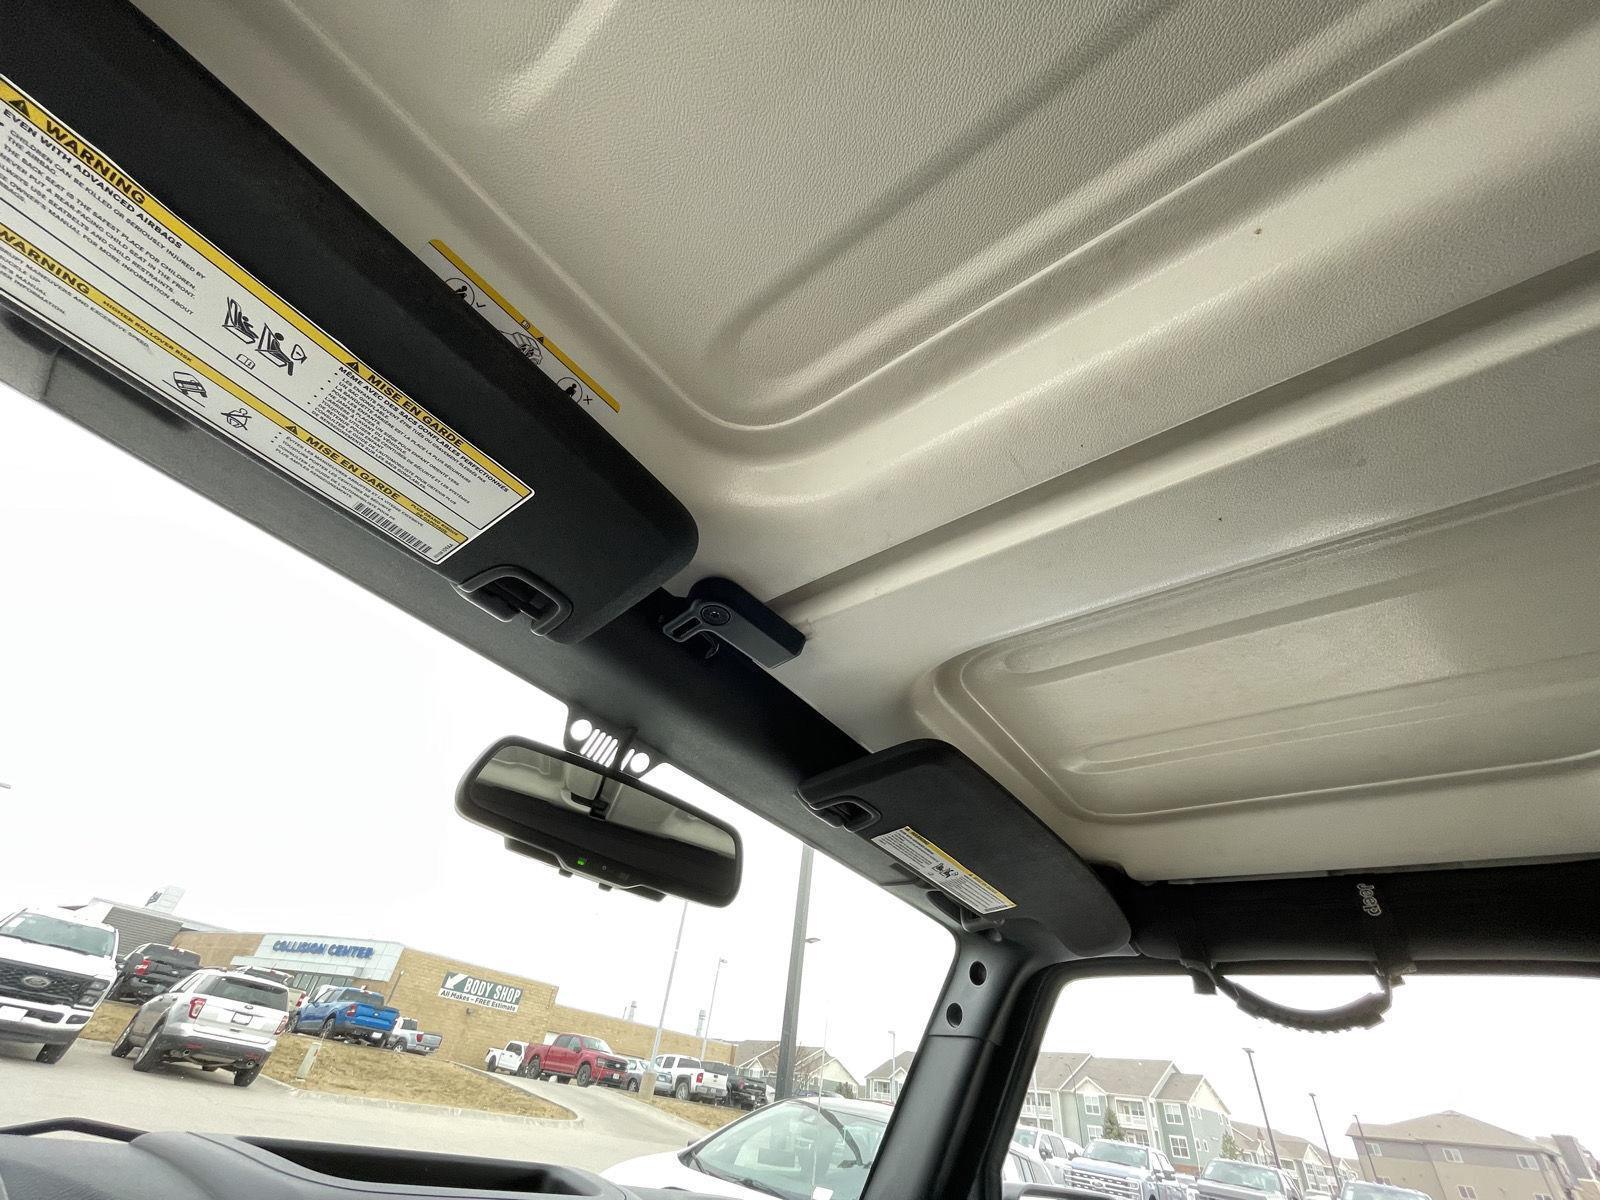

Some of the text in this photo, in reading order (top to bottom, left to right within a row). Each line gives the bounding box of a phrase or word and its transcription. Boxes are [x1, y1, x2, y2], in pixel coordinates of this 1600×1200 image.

[4, 135, 25, 151] THE
[45, 118, 147, 205] WARNING
[1, 108, 184, 248] EVEN WITH ADVANCED AIRBAGS
[1, 144, 21, 158] THE
[19, 157, 45, 176] BACK
[43, 175, 65, 191] SEAT
[74, 198, 93, 212] THE
[91, 211, 120, 232] SAFEST
[120, 232, 146, 252] PLACE
[144, 251, 161, 263] FOR
[7, 129, 54, 164] CHILDREN
[52, 163, 72, 178] CAN
[71, 177, 87, 189] BE
[83, 187, 113, 209] KILLED
[124, 217, 166, 249] SERIOUSLY
[165, 248, 196, 272] INJURED
[27, 174, 46, 188] PUT
[104, 231, 129, 249] CHILD
[128, 249, 147, 263] SEAT
[156, 269, 171, 281] THE
[46, 199, 90, 231] SEATBELTS
[90, 231, 108, 244] AND
[106, 243, 131, 261] CHILD
[46, 208, 82, 235] MANUAL
[81, 234, 99, 247] FOR
[97, 246, 122, 263] MORE
[121, 262, 171, 299] INFORMATION
[170, 298, 194, 315] ABOUT
[133, 322, 175, 350] ROLLOVER
[174, 349, 193, 362] RISK
[337, 365, 509, 492] MÊME AVEC DES SACS GONFLABLES PERFECTIONNÉS
[366, 374, 464, 447] MISE EN GARDE
[304, 436, 340, 460] MISE
[339, 459, 359, 472] EN
[358, 471, 400, 499] GARDE
[1356, 883, 1382, 916] Jeep
[273, 940, 374, 959] COLLISION CENTER
[450, 992, 469, 1001] Makes
[475, 997, 490, 1007] FREE
[491, 1001, 516, 1012] Estimate
[464, 977, 521, 1004] BODY SHOP
